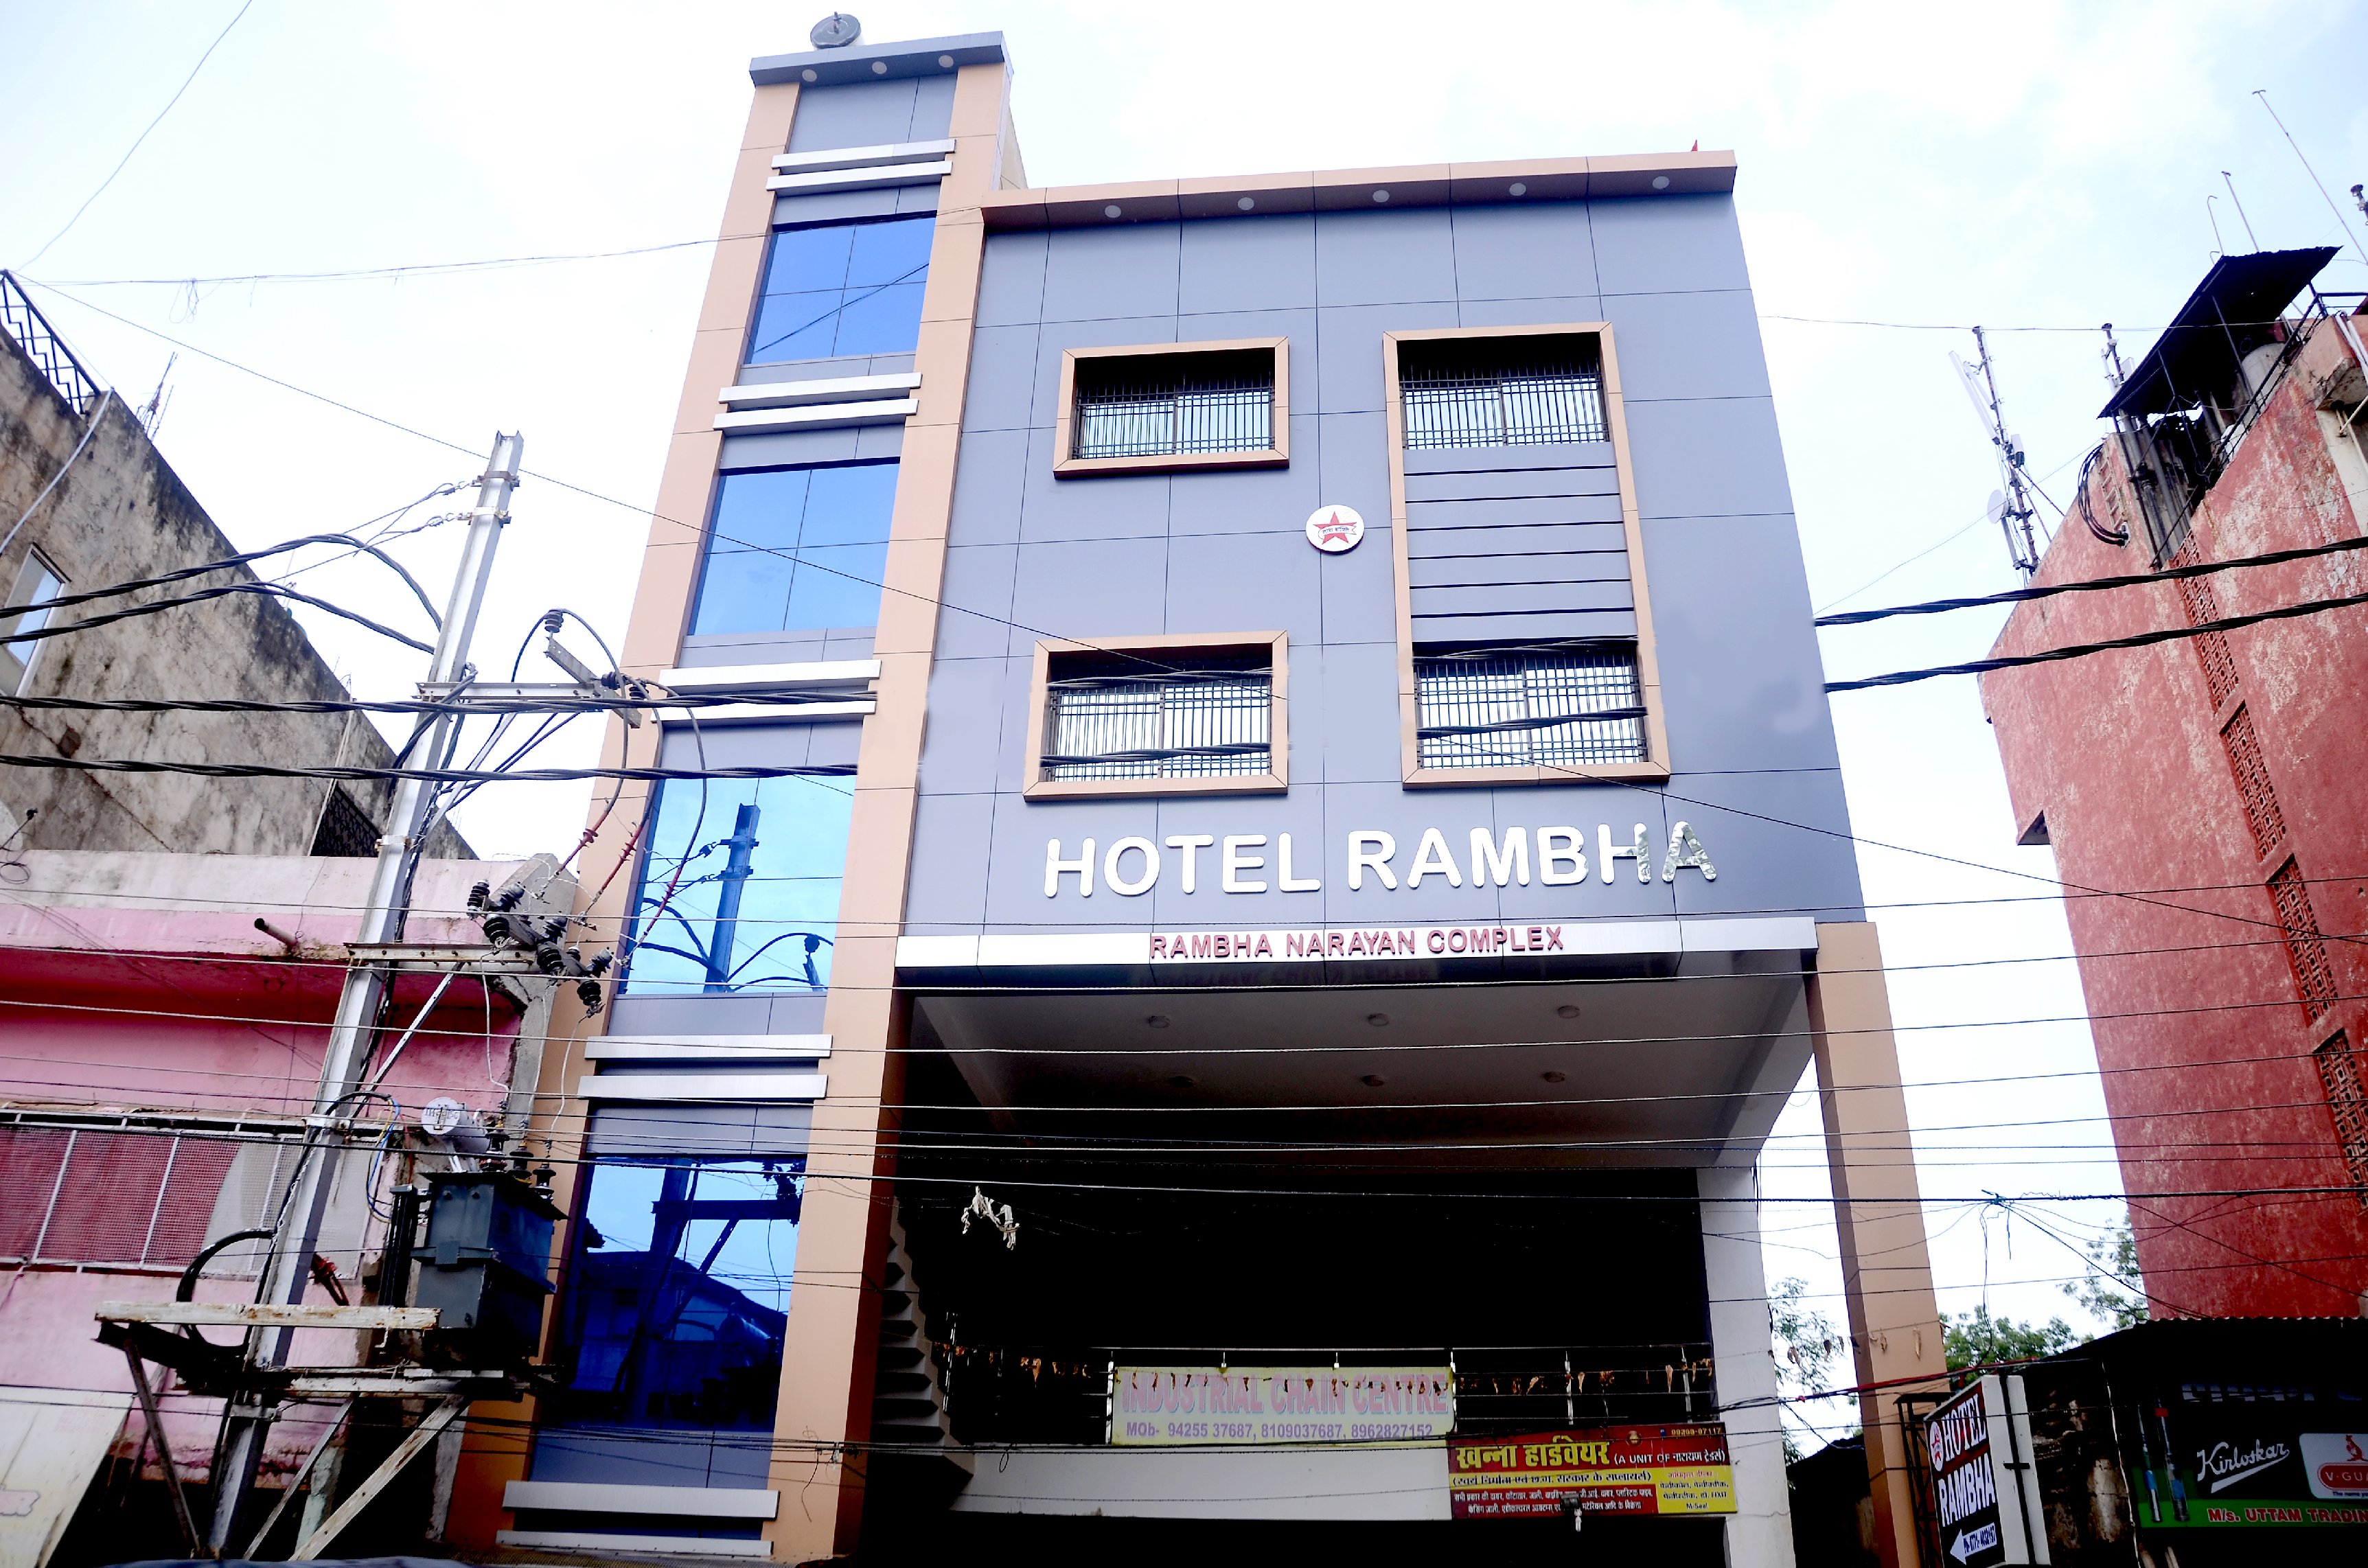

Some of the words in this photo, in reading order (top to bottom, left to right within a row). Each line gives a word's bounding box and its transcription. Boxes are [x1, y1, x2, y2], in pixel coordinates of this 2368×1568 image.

[1044, 831, 1321, 898] HOTEL
[1348, 820, 1718, 891] RAMBHA
[1150, 933, 1272, 960] RAMBHA
[1287, 929, 1415, 957] NARAYAN
[1426, 925, 1564, 954] COMPLEX
[1122, 1373, 1264, 1414] INDUSTRIAL
[1271, 1373, 1346, 1414] CHAIN
[1353, 1374, 1449, 1414] CENTRE
[1168, 1422, 1208, 1437] 94255
[1212, 1423, 1256, 1440] 37687,
[1261, 1423, 1346, 1440] 8109037687,
[1351, 1423, 1434, 1438] 8962827152
[1941, 1393, 1987, 1462] HOTEL
[1456, 1444, 1517, 1469] खन्ना
[1523, 1435, 1610, 1467] हार्डवेयर
[1614, 1453, 1626, 1465] (A
[1629, 1453, 1653, 1464] UNIT
[1657, 1453, 1670, 1464] OF
[1672, 1451, 1703, 1462] नारायण
[2197, 1438, 2290, 1482] Kirloskar
[1938, 1452, 1996, 1527] RAMBHA
[2207, 1508, 2240, 1523] M/s.
[2244, 1508, 2303, 1523] UTTAM
